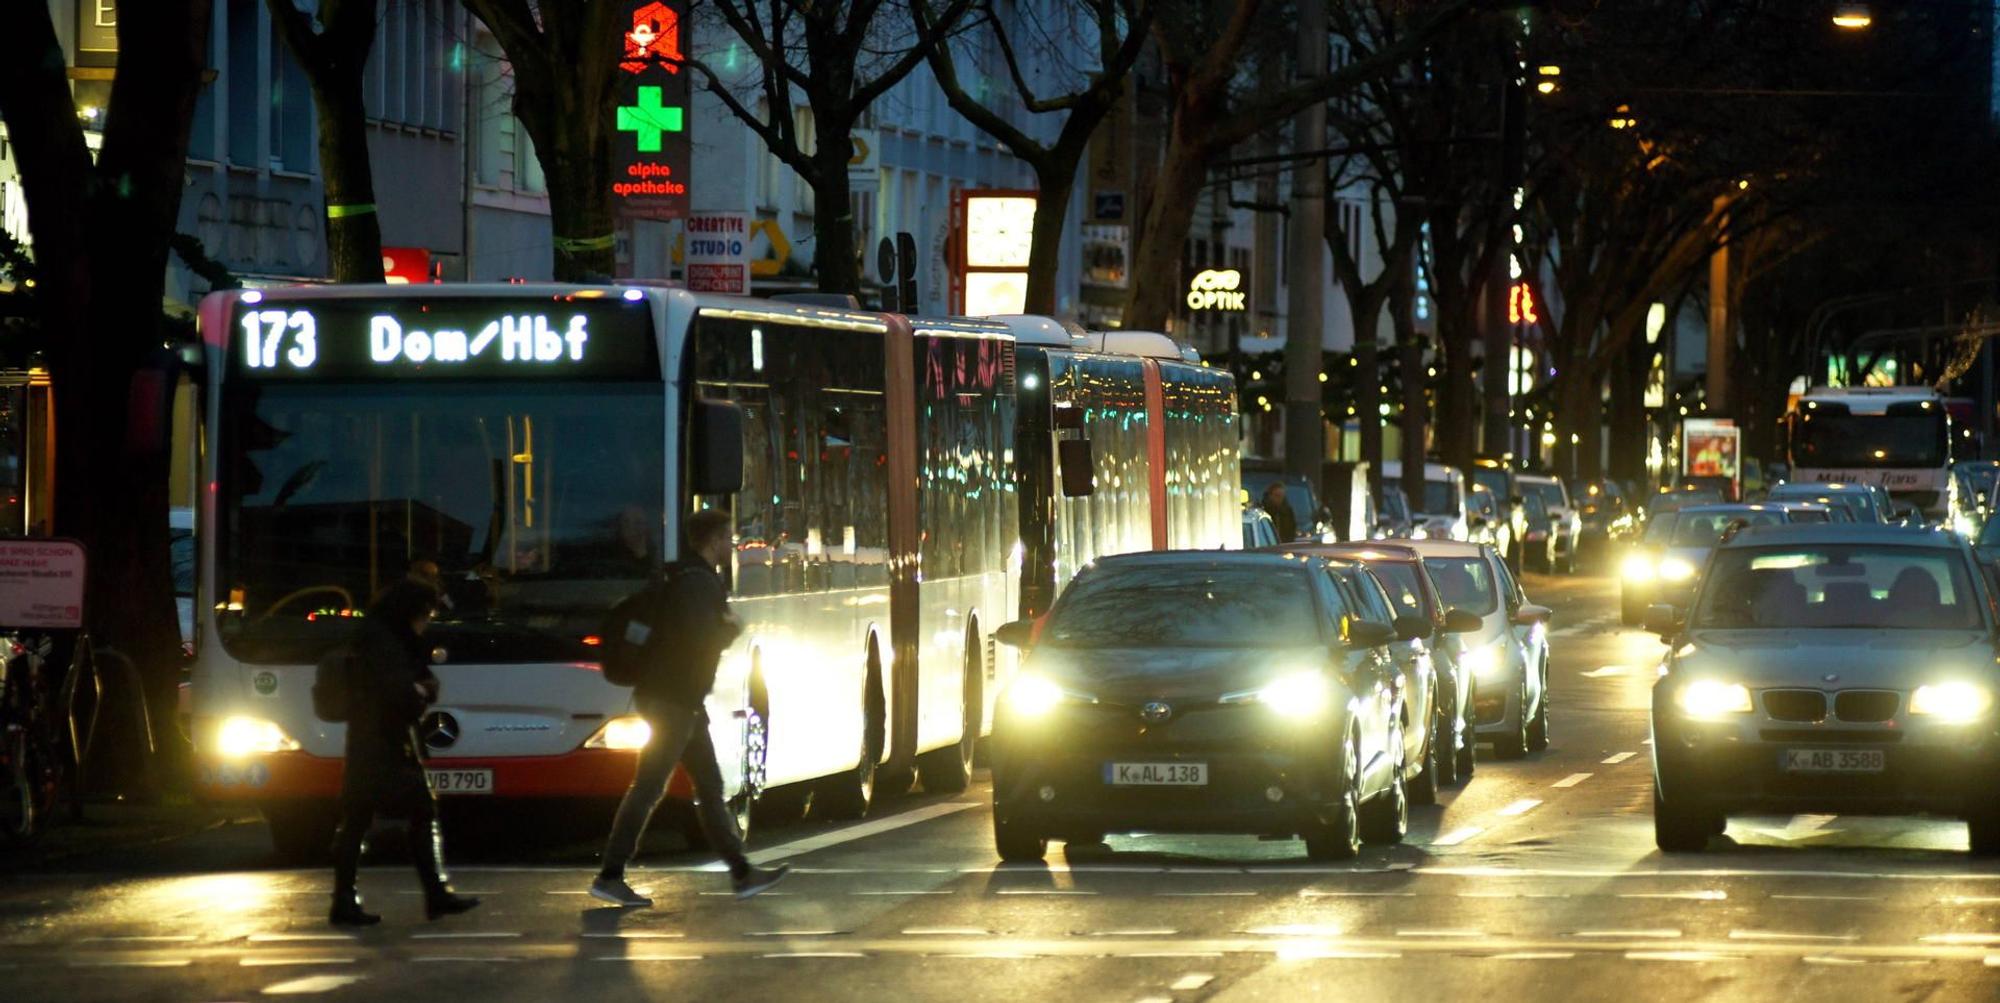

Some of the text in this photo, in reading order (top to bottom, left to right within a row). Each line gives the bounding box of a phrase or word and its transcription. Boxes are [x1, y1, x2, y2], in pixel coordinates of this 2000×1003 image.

[627, 162, 671, 179] alpha
[612, 181, 686, 197] apotheke
[1187, 290, 1245, 310] OPTIK
[241, 310, 588, 368] 173 Dom/Hbf
[1838, 751, 1881, 769] 3588
[454, 773, 485, 789] 790
[1167, 765, 1199, 782] 138
